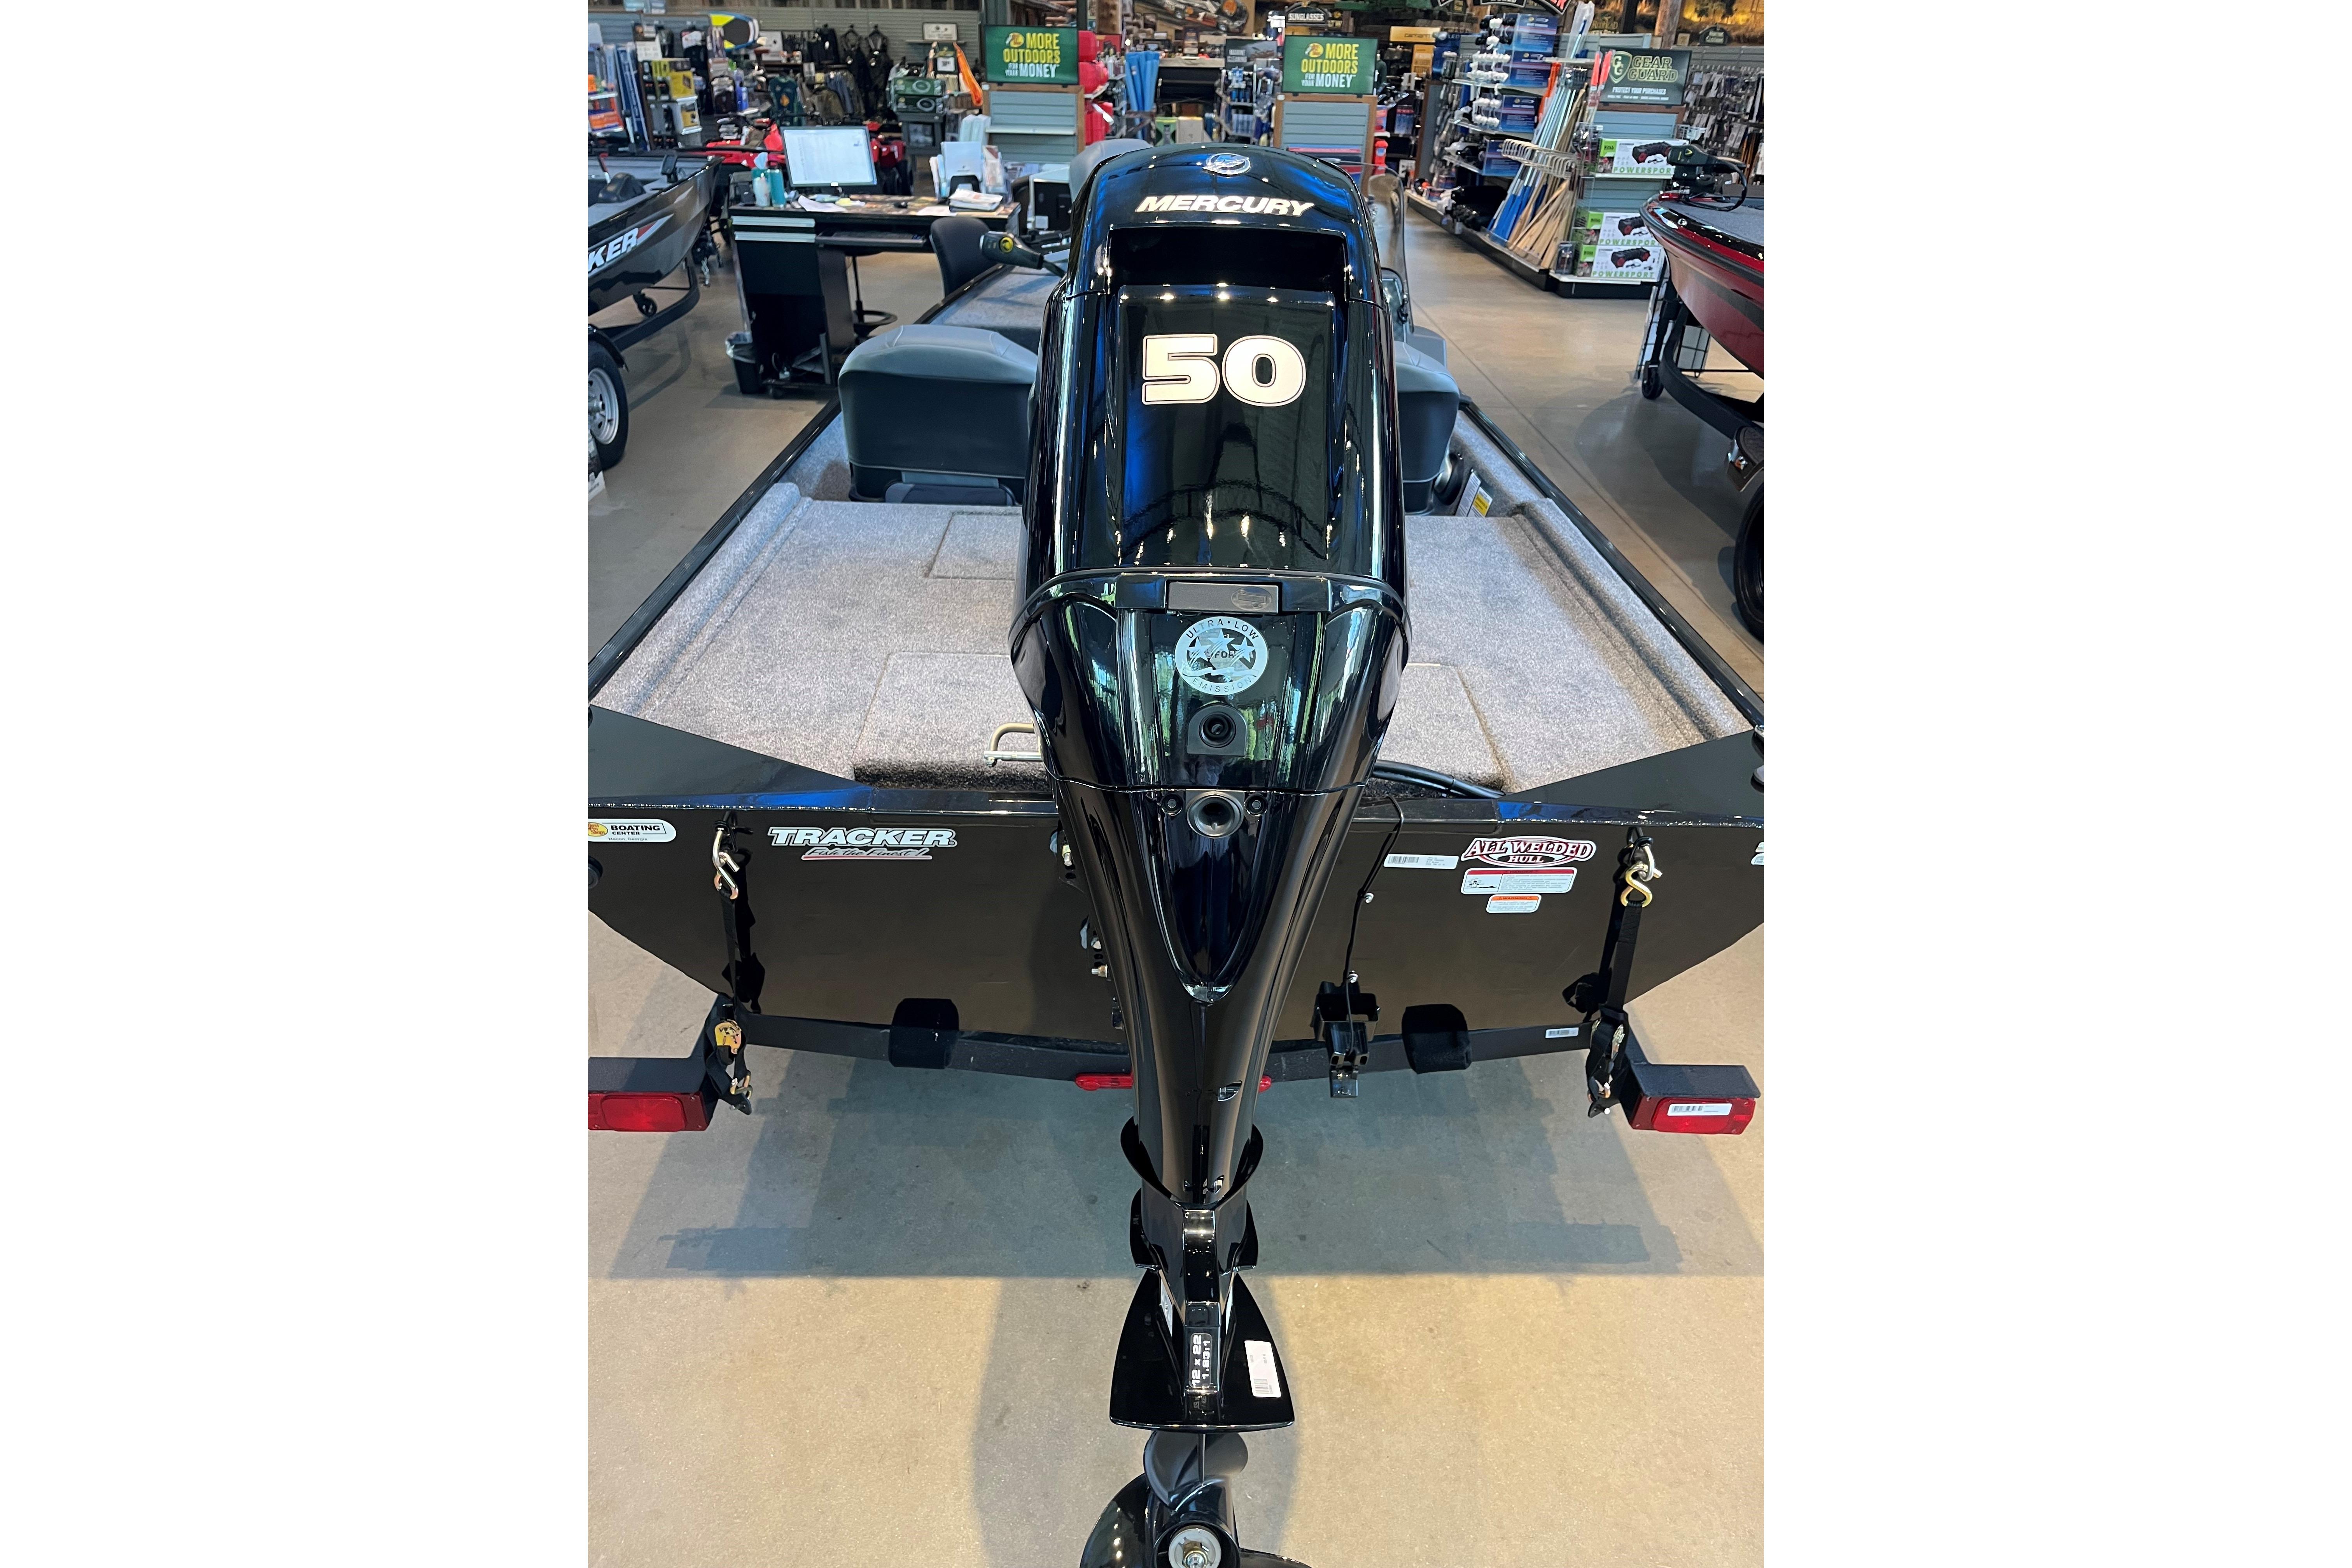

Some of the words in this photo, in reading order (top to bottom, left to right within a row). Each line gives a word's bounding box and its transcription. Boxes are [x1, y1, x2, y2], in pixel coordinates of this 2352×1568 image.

[1288, 13, 1324, 21] SUNGLASSES
[1026, 33, 1060, 49] MORE
[1003, 48, 1061, 64] OUTDOORS
[1325, 43, 1360, 60] MORE
[1301, 59, 1358, 74] OUTDOORS
[1632, 55, 1673, 69] GEAR
[1019, 63, 1057, 78] MONEY
[1627, 67, 1678, 82] GUARD
[1315, 73, 1353, 88] MONEY
[1135, 195, 1315, 217] MERCURY
[1143, 334, 1306, 407] 50
[1186, 619, 1223, 639] ULTRA
[1234, 621, 1259, 640] LOW
[1192, 677, 1252, 693] EMISSION
[770, 828, 957, 846] TRACKER
[1465, 840, 1508, 858] ALL
[1510, 840, 1593, 859] WELDED
[1507, 855, 1544, 863] HULL
[1193, 1335, 1202, 1355] 22
[1202, 1340, 1211, 1380] 1.83:1
[1192, 1369, 1200, 1387] 12
